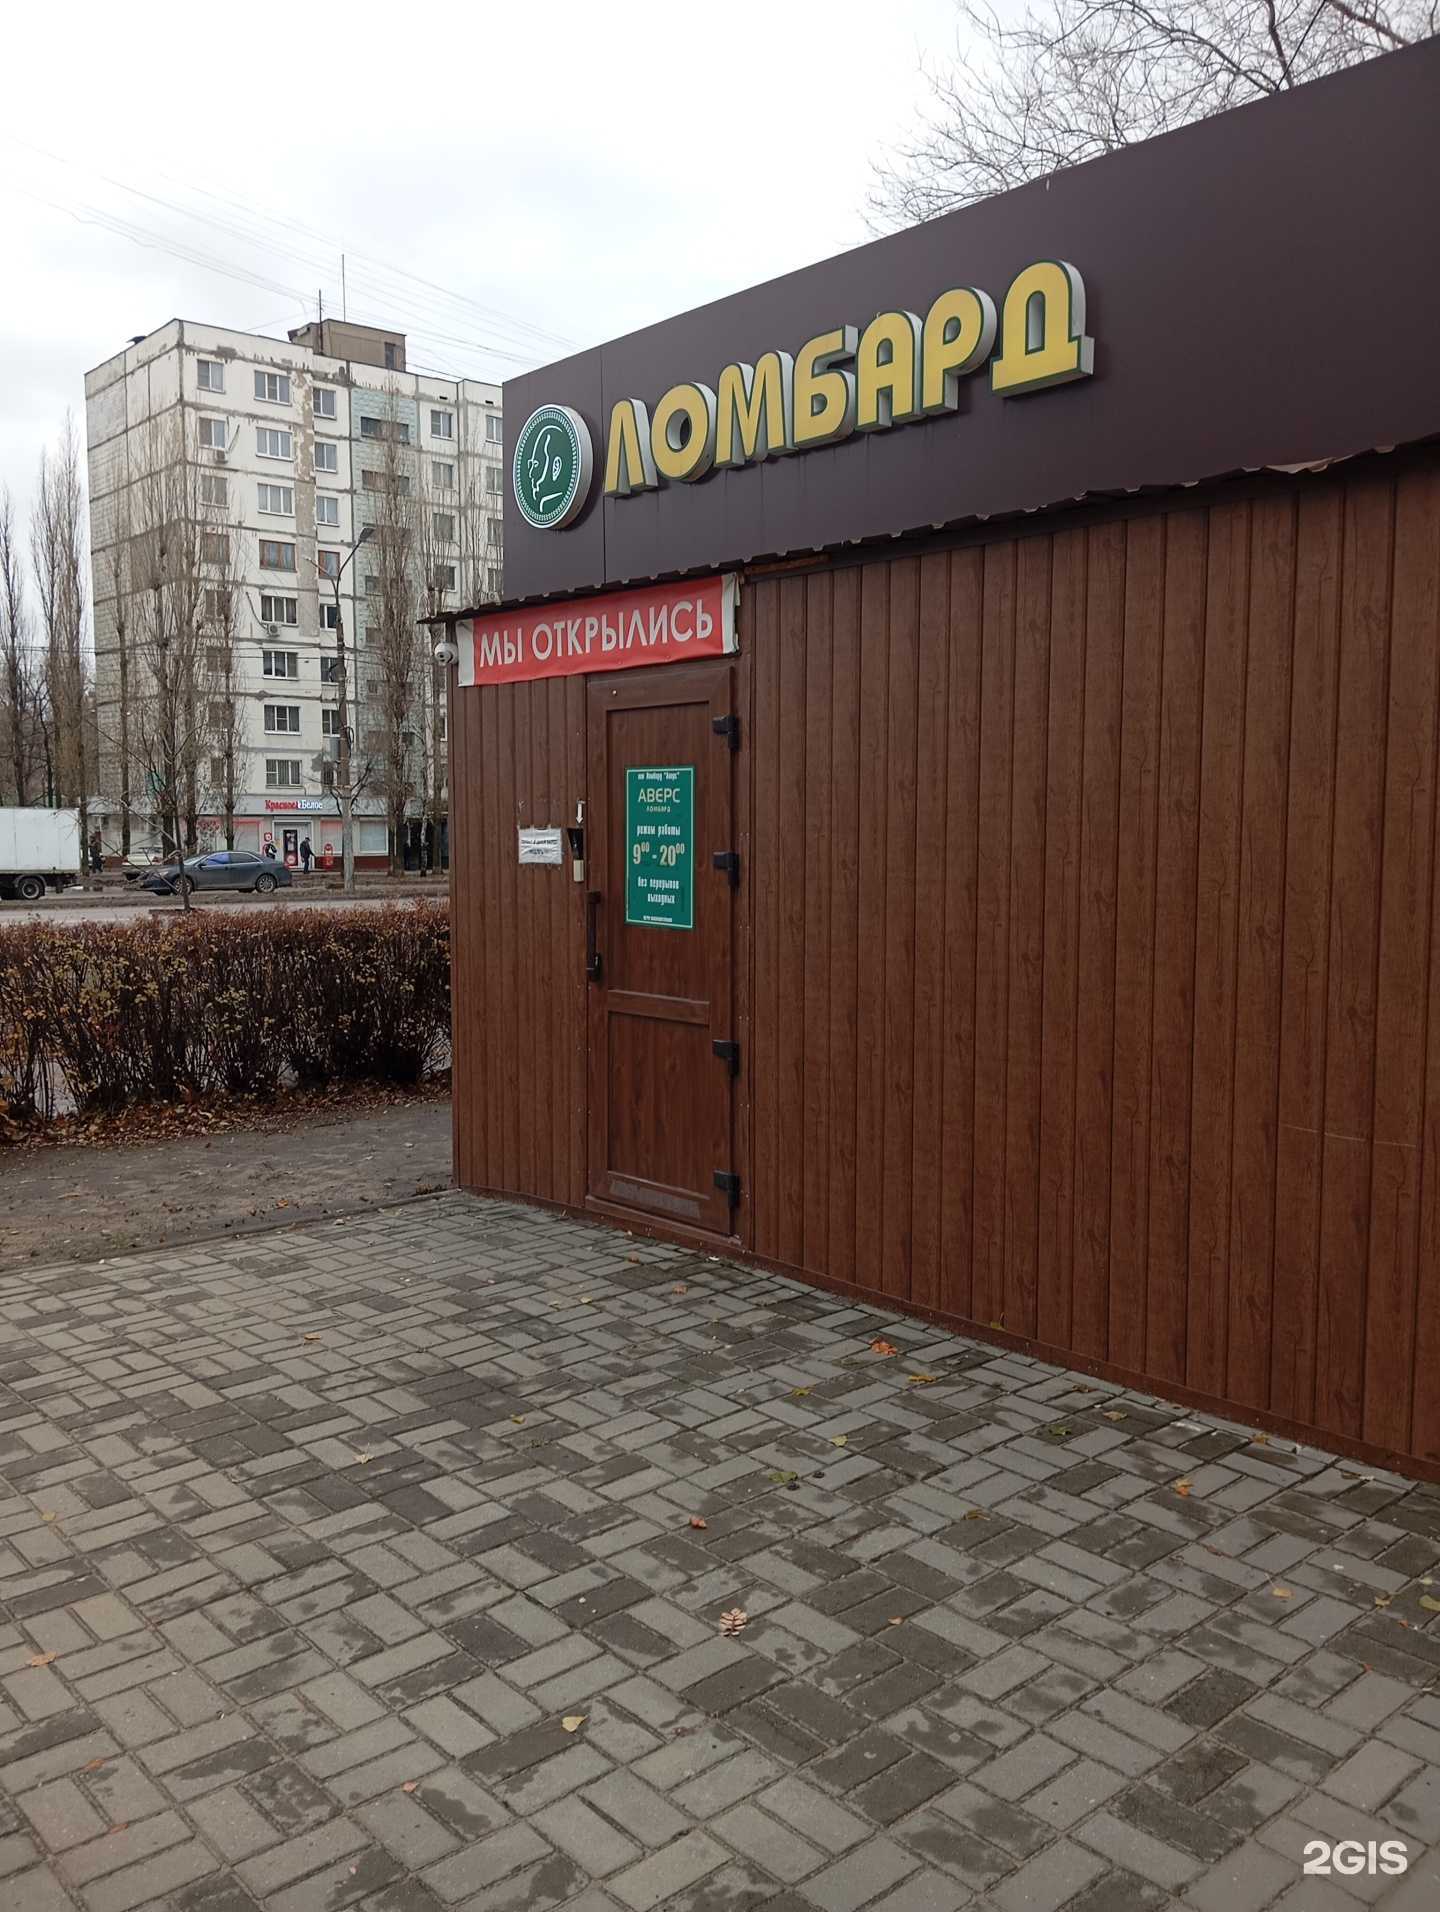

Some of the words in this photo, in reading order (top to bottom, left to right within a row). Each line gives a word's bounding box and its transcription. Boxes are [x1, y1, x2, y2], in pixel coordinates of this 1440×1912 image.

[603, 259, 1095, 497] ЛОМБАРД
[480, 627, 523, 668] МЫ
[531, 599, 713, 661] ОТКРЫЛИСЬ
[638, 788, 681, 803] АВЕРС
